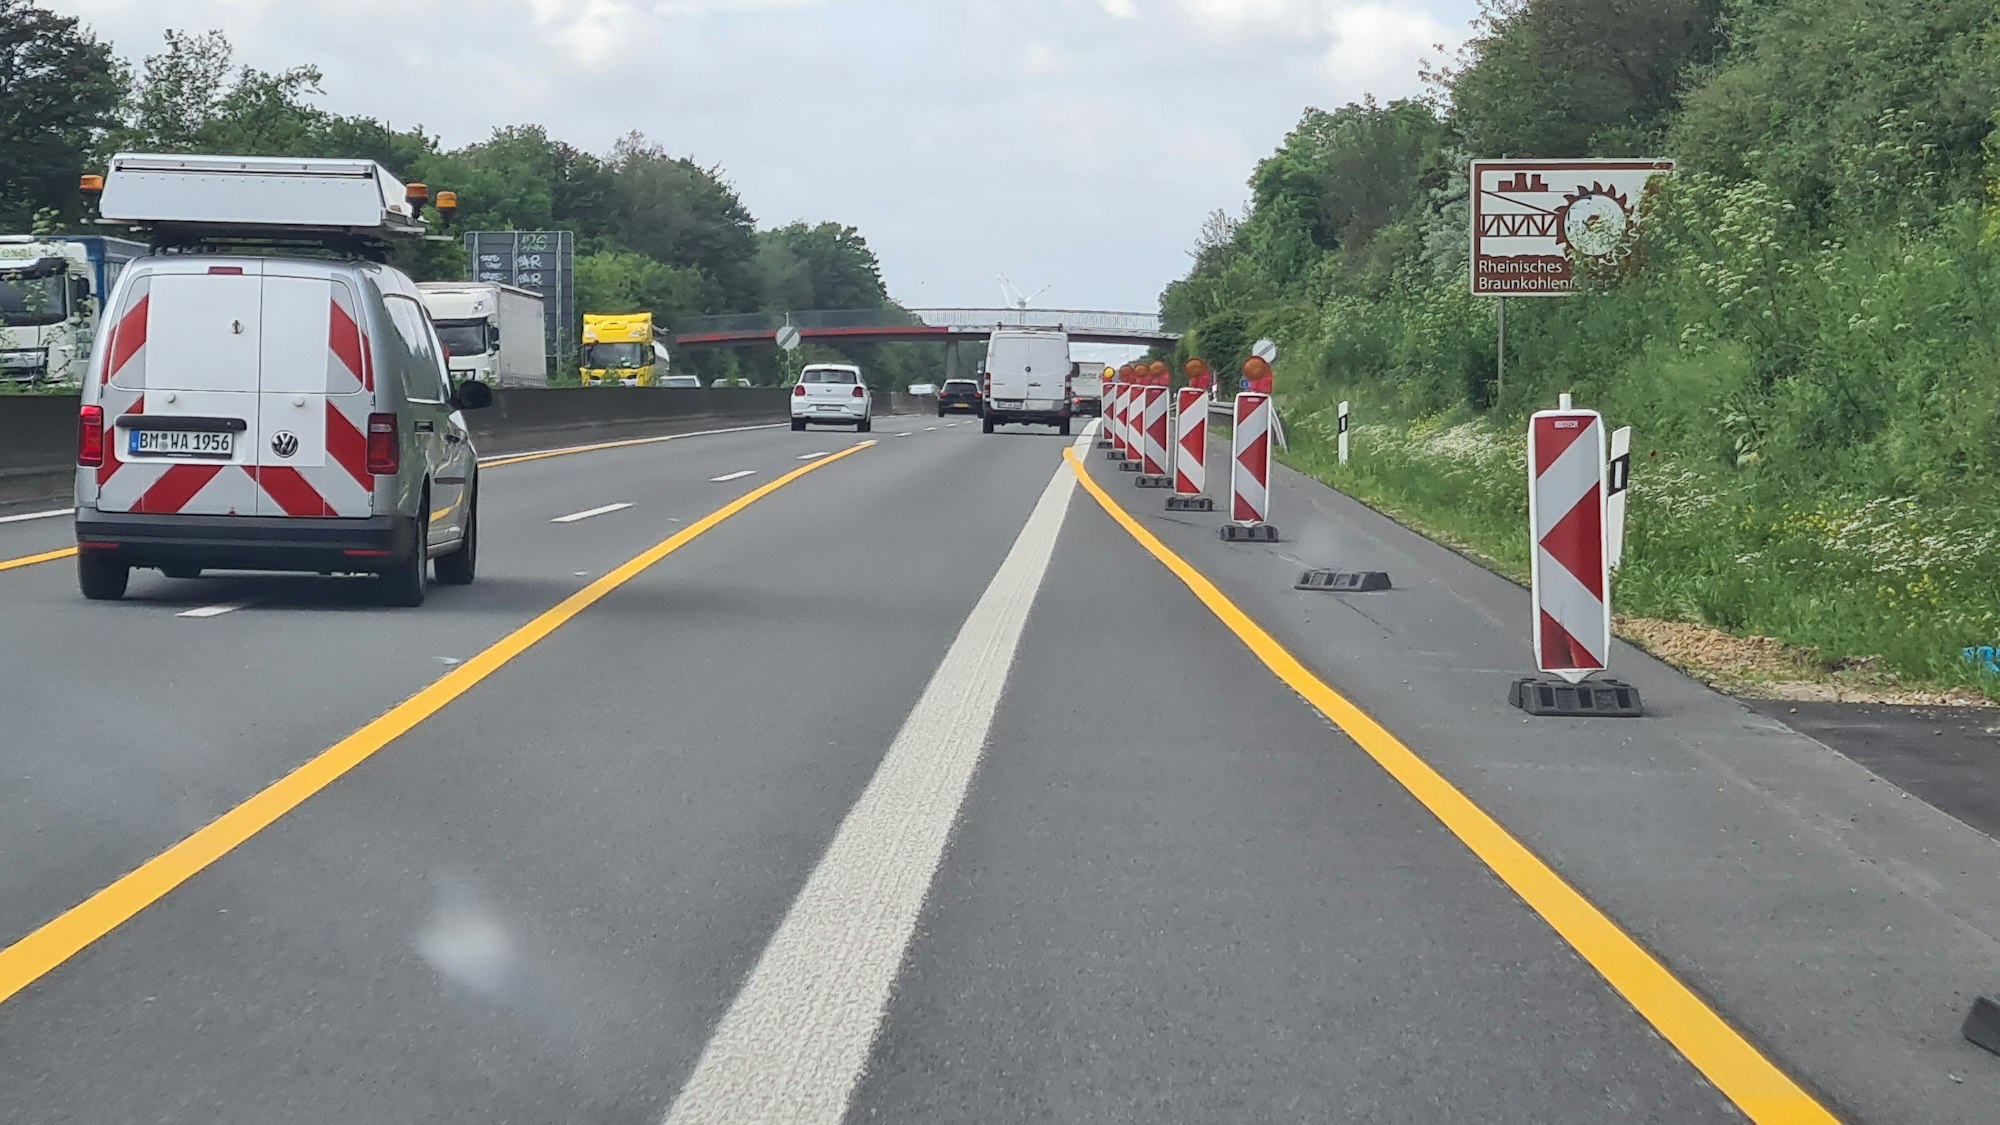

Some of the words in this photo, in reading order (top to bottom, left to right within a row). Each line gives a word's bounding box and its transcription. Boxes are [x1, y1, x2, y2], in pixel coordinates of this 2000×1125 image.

[1479, 260, 1563, 273] Rheinisches
[140, 433, 159, 449] BM
[170, 433, 188, 449] WA
[192, 434, 229, 451] 1956
